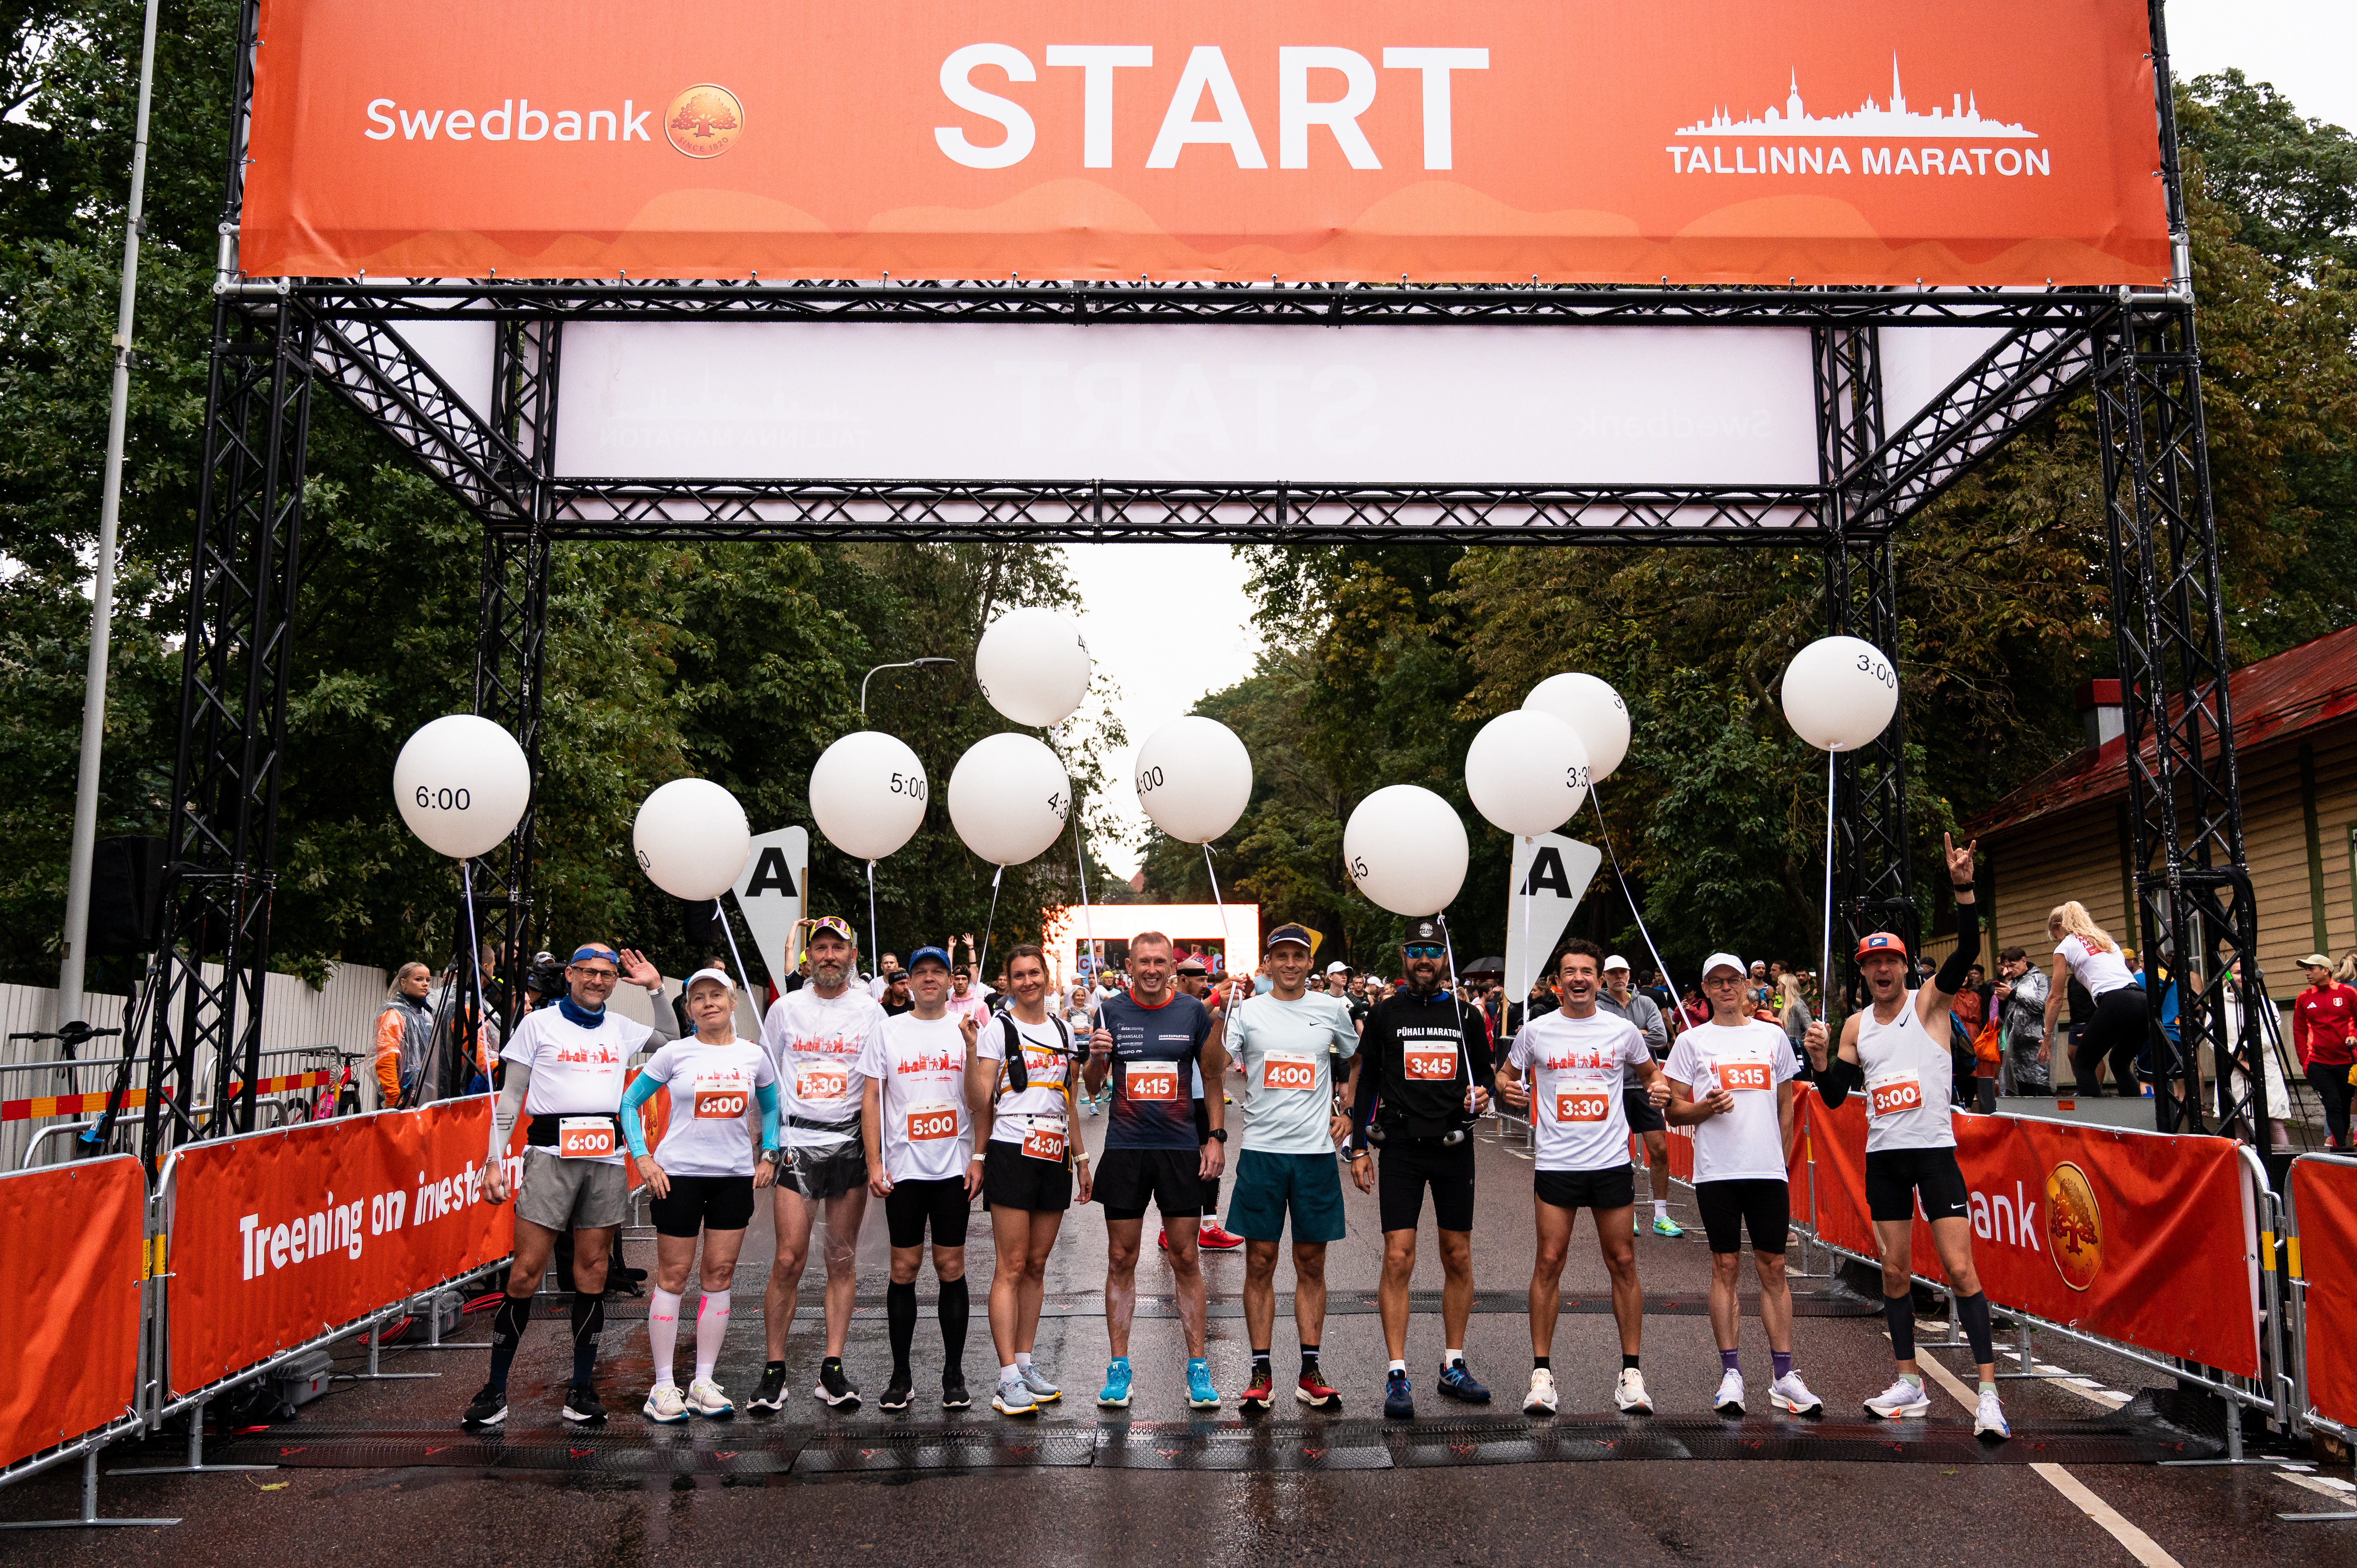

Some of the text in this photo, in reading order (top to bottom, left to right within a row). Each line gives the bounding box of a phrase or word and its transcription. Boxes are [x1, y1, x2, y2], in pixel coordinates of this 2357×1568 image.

[934, 42, 1489, 170] START
[364, 98, 652, 142] Swedbank
[678, 136, 728, 152] SINCE 1820
[1665, 146, 2050, 176] TALLINNA MARATON
[1857, 655, 1895, 688] 3:00
[891, 773, 925, 801] 5:00
[416, 786, 470, 810] 6:00
[745, 847, 798, 897] A
[1519, 846, 1573, 899] A
[1079, 958, 1089, 969] C
[1397, 1027, 1462, 1038] PÜHALI MARATON
[1268, 1067, 1311, 1084] 4:00
[1411, 1058, 1451, 1074] 3:45
[802, 1077, 841, 1094] 5:30
[1133, 1078, 1170, 1094] 4:15
[1727, 1069, 1764, 1084] 3:15
[700, 1097, 743, 1113] 6:00
[1562, 1099, 1604, 1116] 3:30
[1876, 1087, 1915, 1110] 3:00
[913, 1116, 953, 1135] 5:00
[567, 1134, 609, 1150] 6:00
[1028, 1135, 1061, 1159] 4:30
[239, 1191, 364, 1281] Treening
[371, 1189, 406, 1236] on
